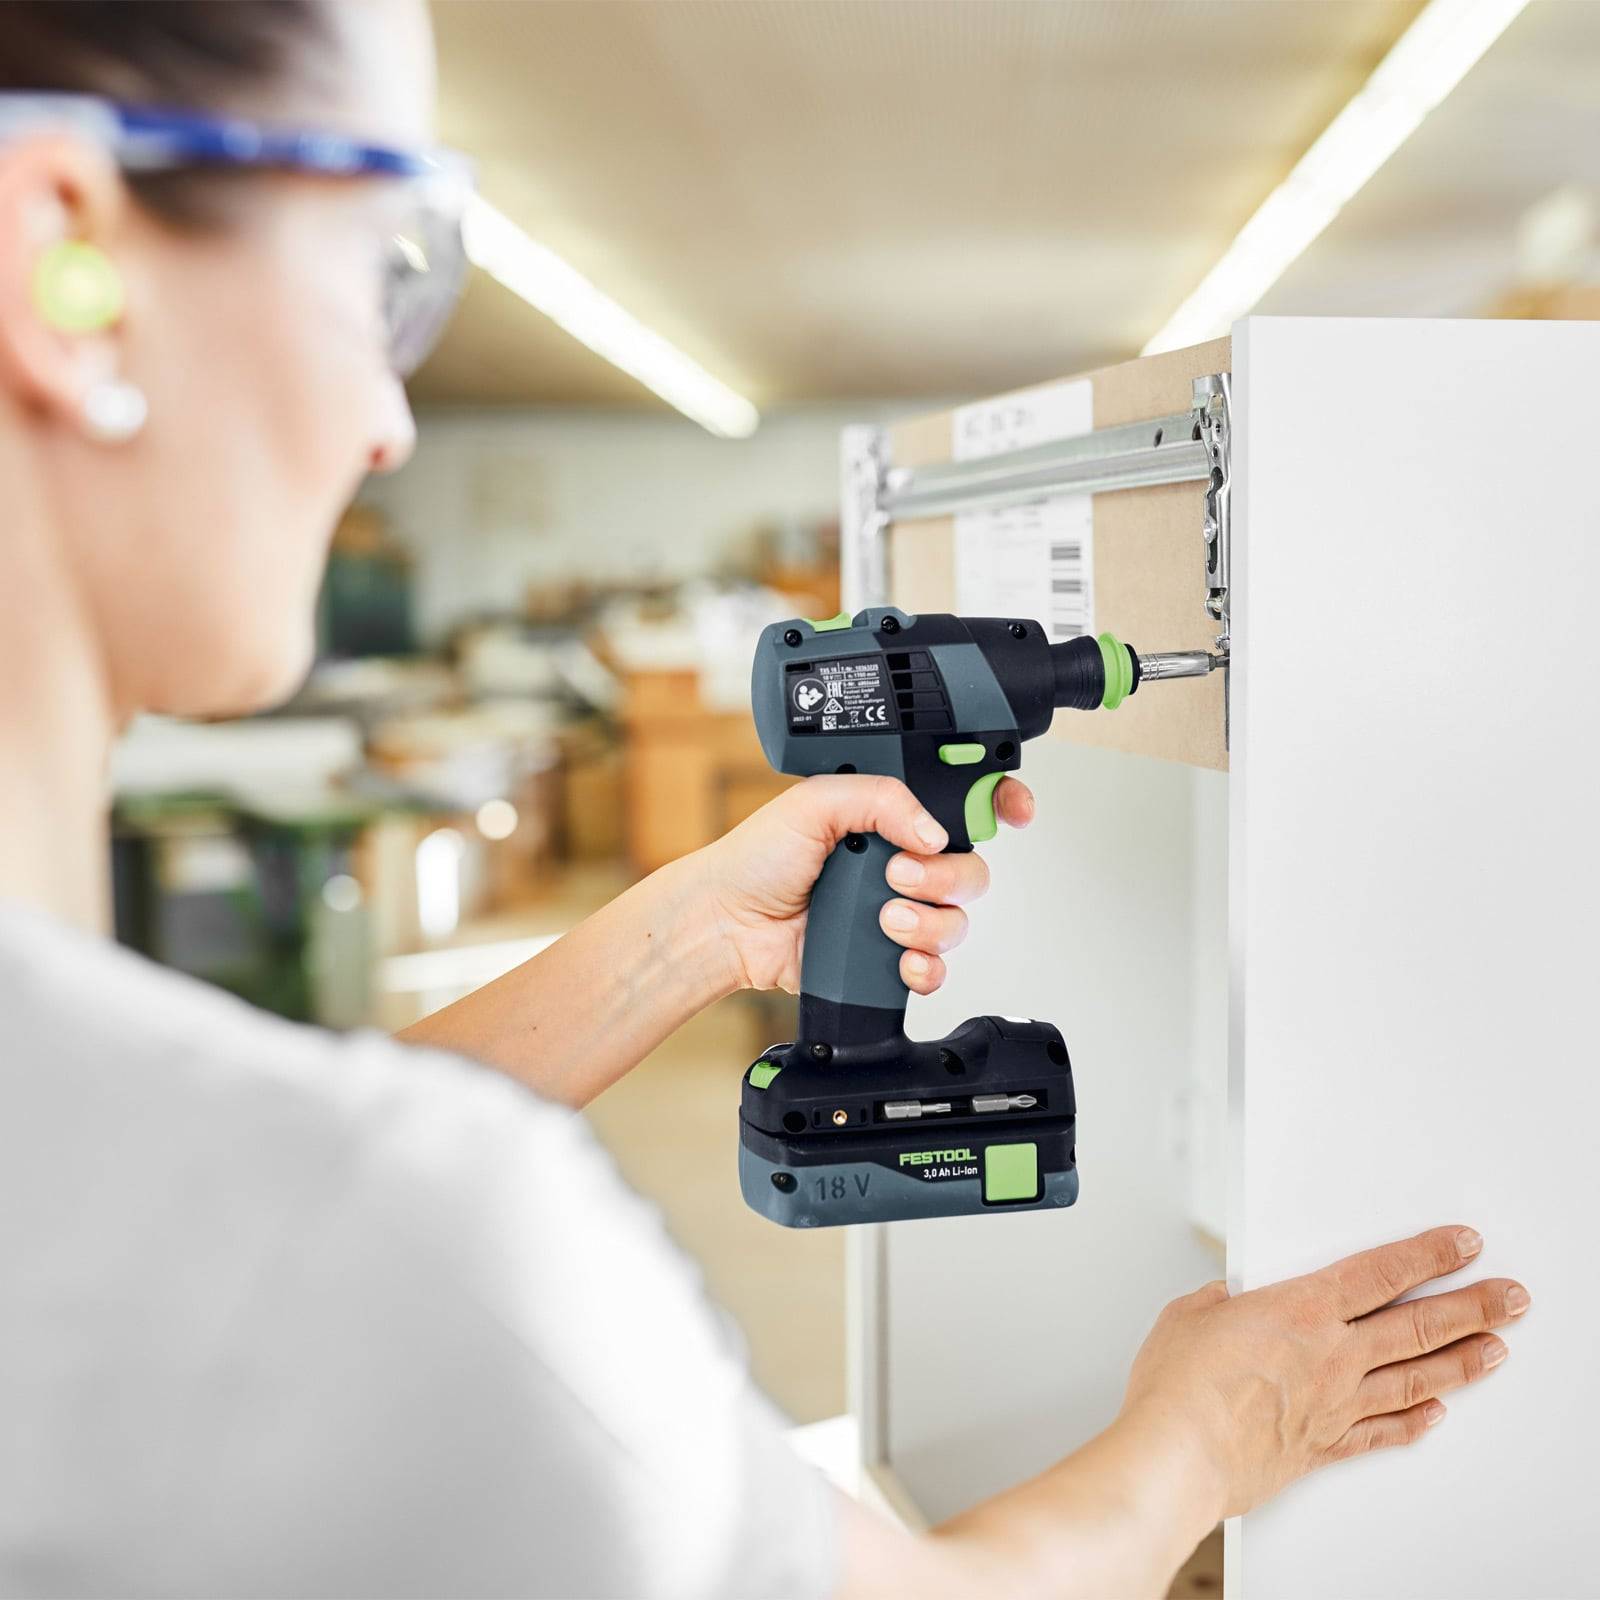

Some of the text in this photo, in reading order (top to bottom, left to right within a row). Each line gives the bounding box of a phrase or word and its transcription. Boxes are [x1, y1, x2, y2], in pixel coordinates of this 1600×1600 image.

[899, 1148, 977, 1165] FESTOOL
[923, 1168, 937, 1178] 3,0
[938, 1168, 950, 1177] Ah
[815, 1174, 870, 1201] 18 V
